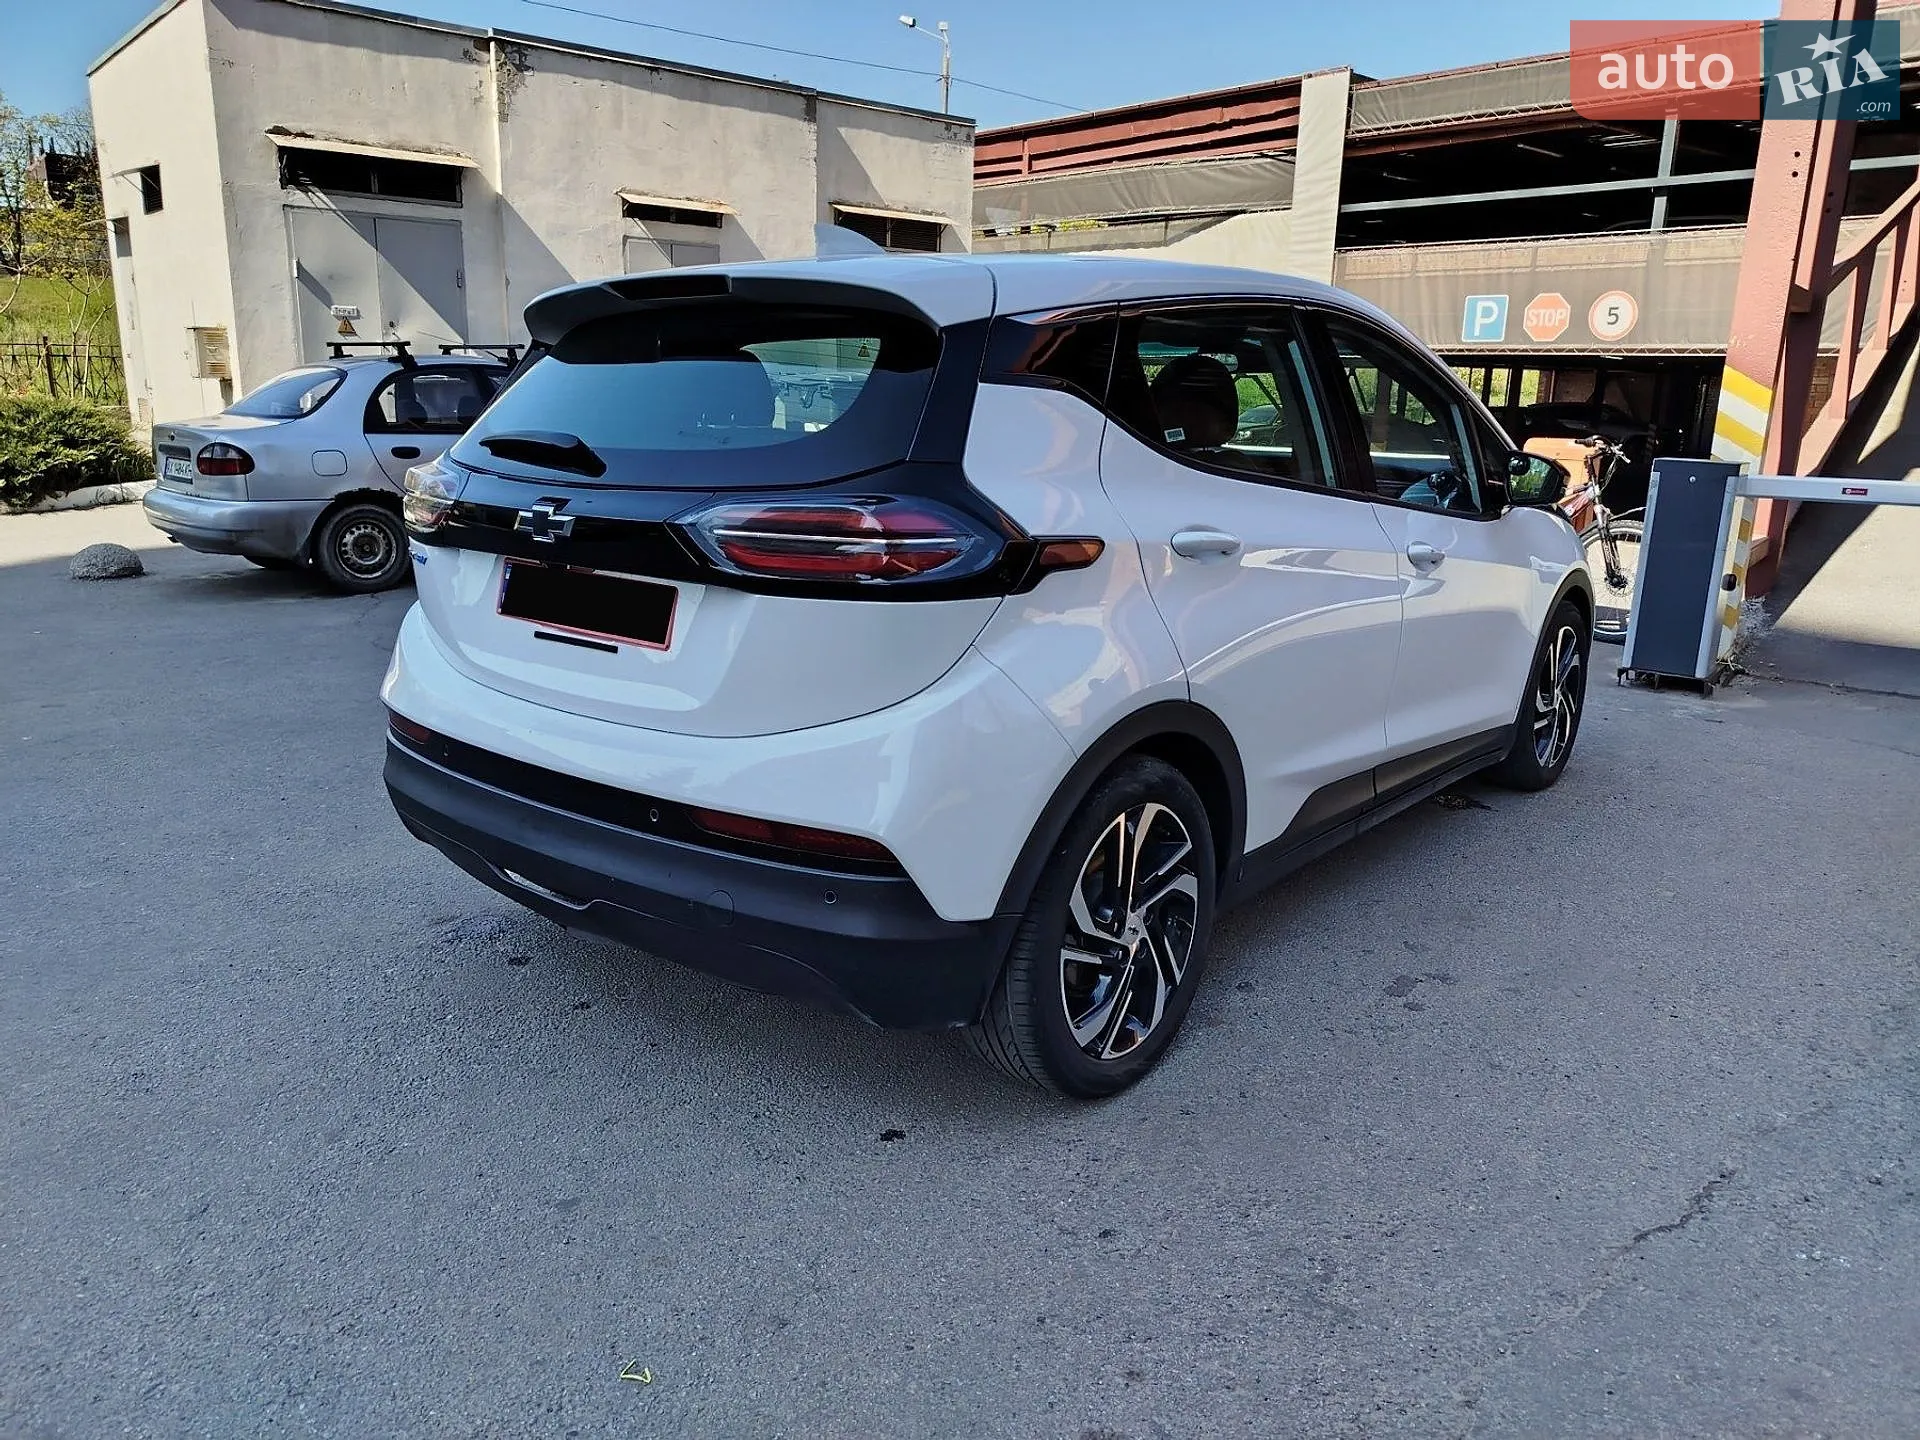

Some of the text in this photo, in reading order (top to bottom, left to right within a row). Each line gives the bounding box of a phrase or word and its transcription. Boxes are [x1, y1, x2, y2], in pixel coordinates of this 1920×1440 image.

[1474, 301, 1499, 337] P
[1527, 308, 1567, 328] STOP
[1607, 306, 1620, 326] 5
